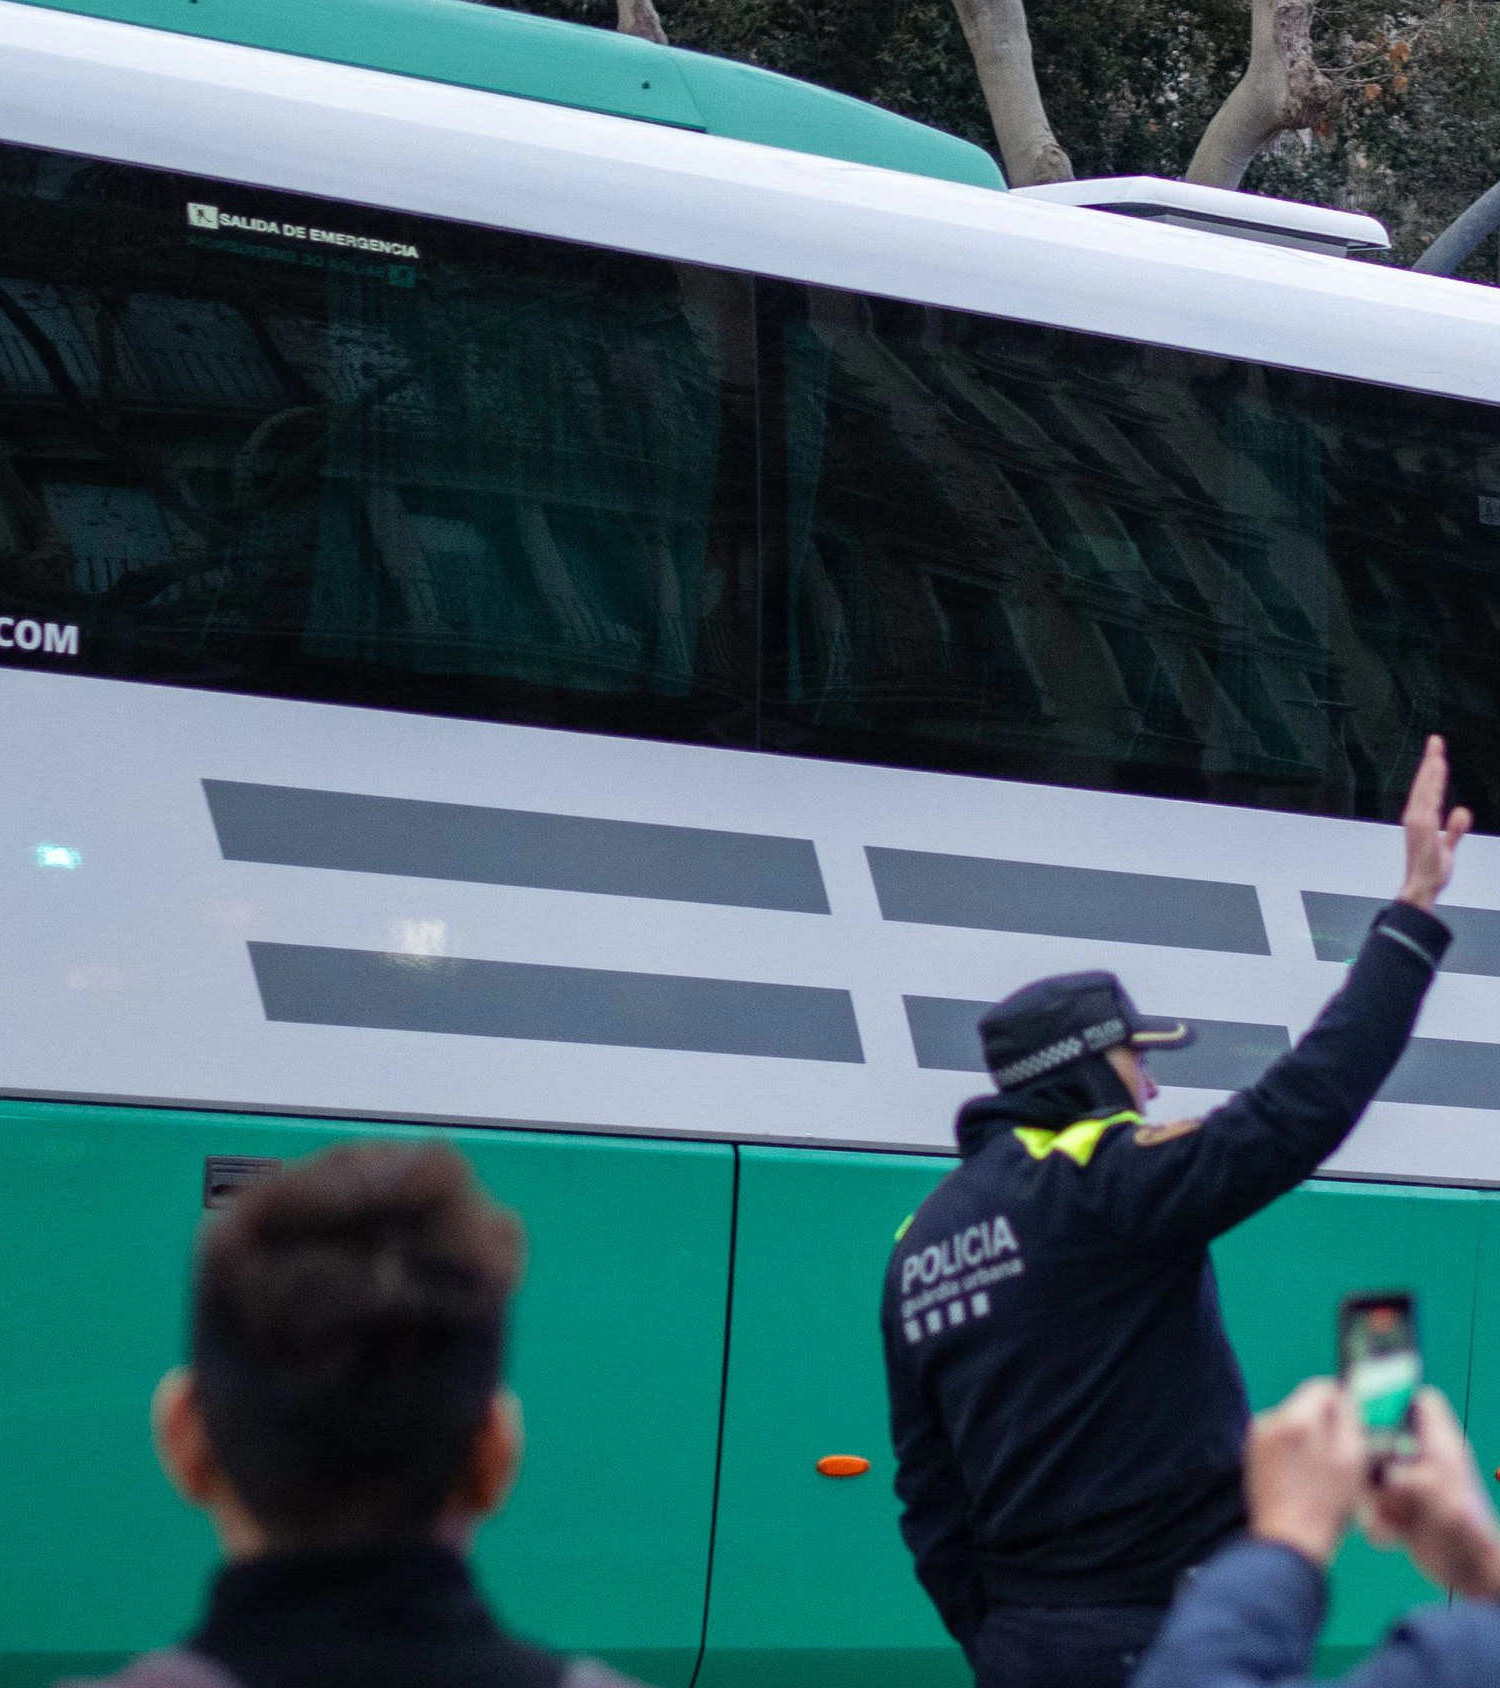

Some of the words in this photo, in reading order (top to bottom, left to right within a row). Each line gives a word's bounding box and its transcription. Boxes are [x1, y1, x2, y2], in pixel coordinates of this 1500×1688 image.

[218, 212, 280, 236] SALIDA
[282, 223, 307, 240] DE
[309, 229, 420, 259] EMERGENCIA
[901, 1215, 1019, 1294] POLICIA
